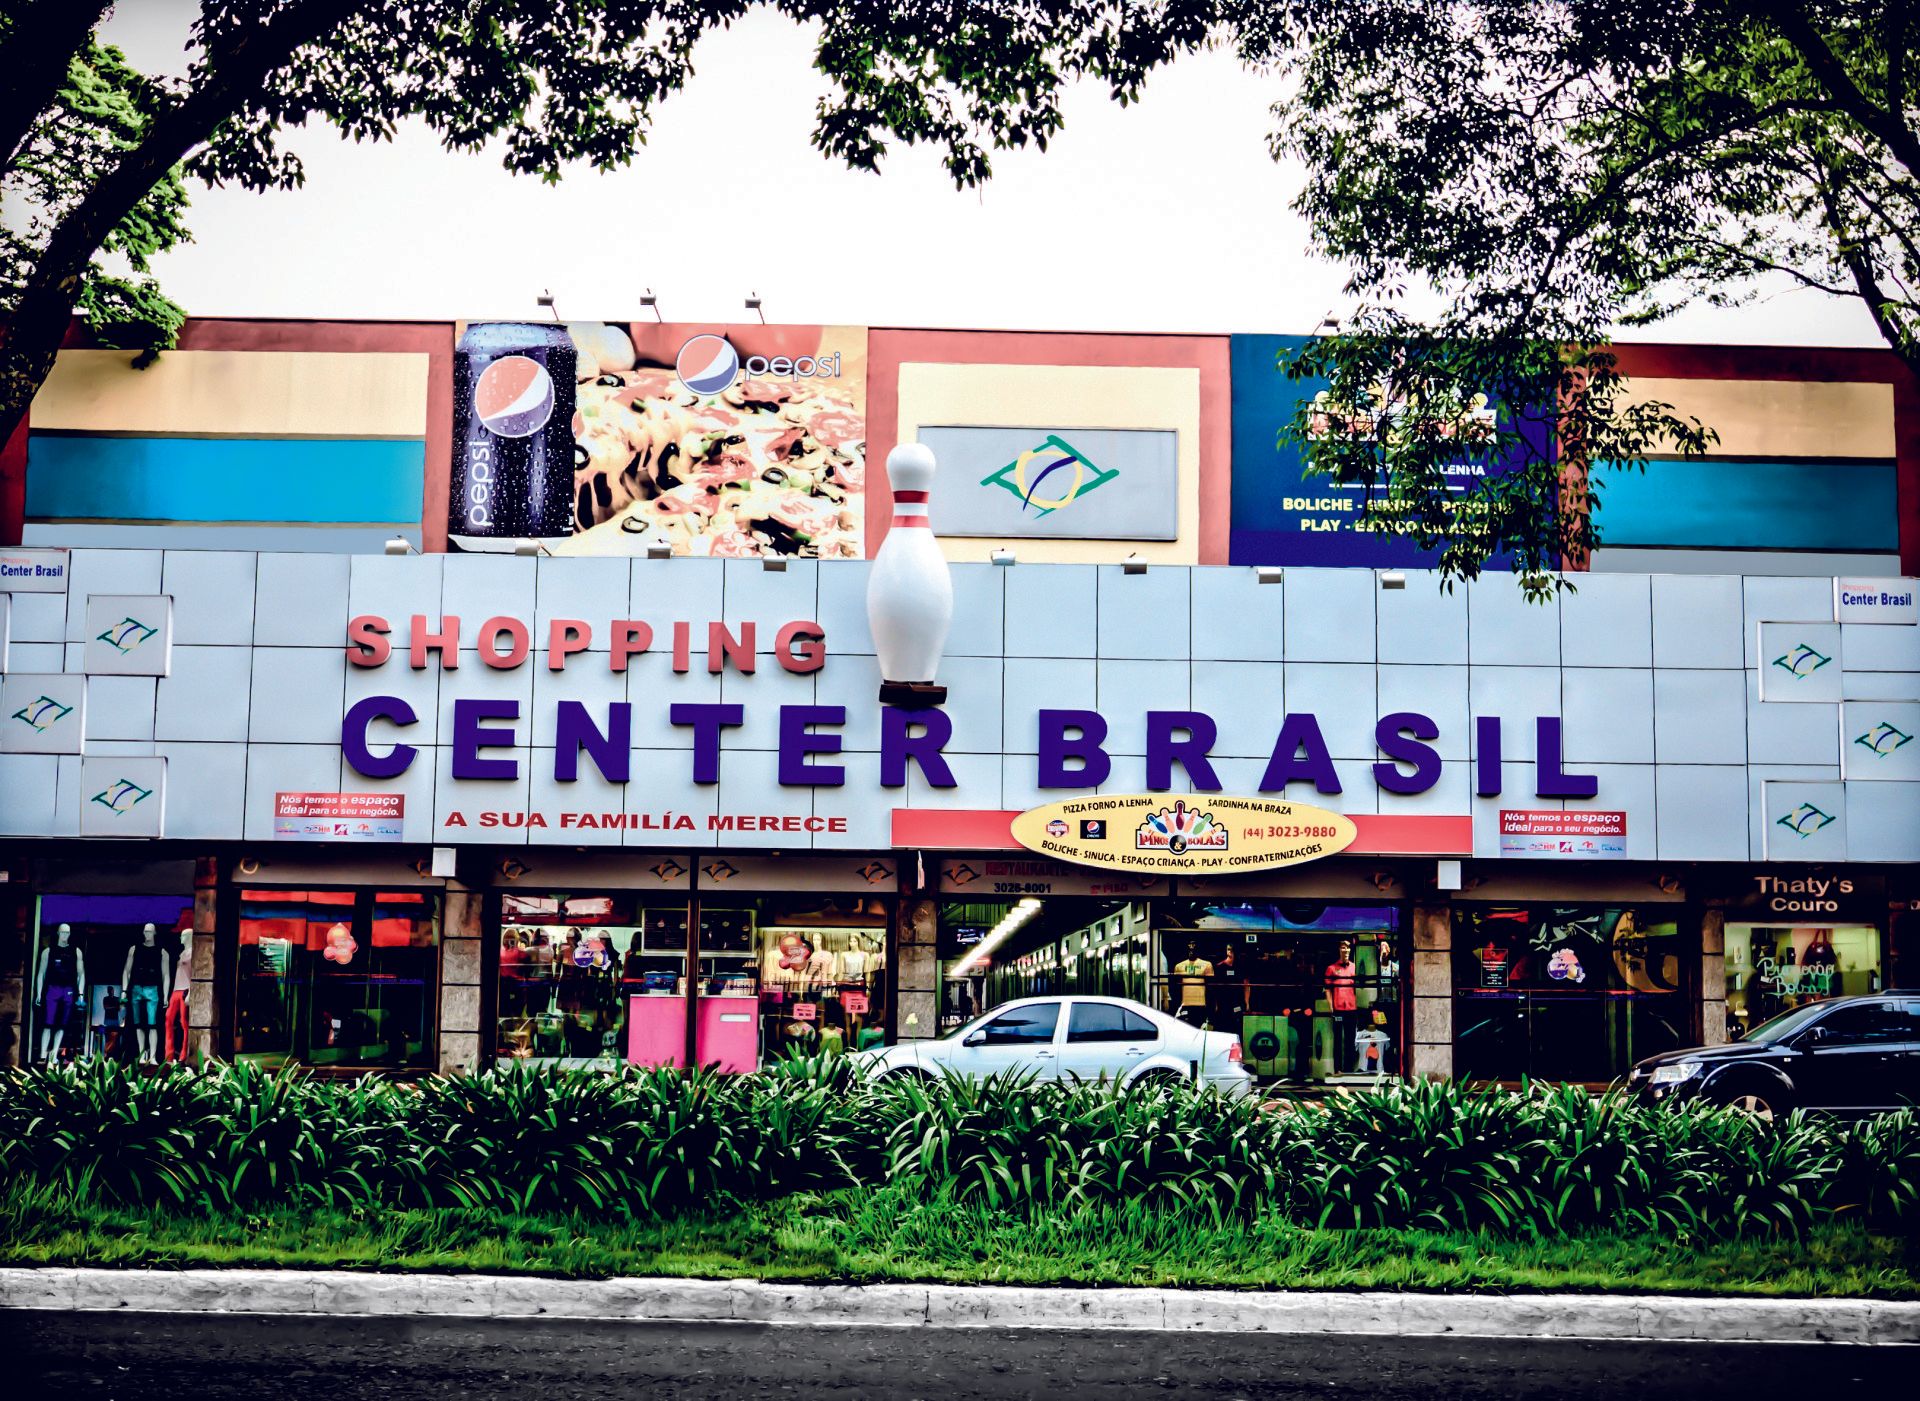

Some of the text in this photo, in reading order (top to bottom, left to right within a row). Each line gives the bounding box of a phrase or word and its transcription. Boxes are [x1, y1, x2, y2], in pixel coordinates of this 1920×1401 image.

[745, 351, 840, 382] pepsi
[469, 441, 493, 526] pepsi
[1283, 497, 1353, 511] BOLICHE
[1301, 519, 1341, 531] PLAY
[1, 565, 63, 577] Center Brasil
[1842, 592, 1912, 606] Center Brasil
[346, 615, 826, 674] SHOPPING
[341, 695, 1598, 799] CENTER BRASIL
[280, 795, 399, 807] Nós temos o espaço
[1063, 798, 1153, 814] PIZZA FORNO A LENHA
[1208, 799, 1292, 815] SARDINHA NA BRAZA
[280, 804, 399, 817] ideal para o seu negócio.
[444, 810, 848, 833] A SUA FAMILÍA MERECE
[1504, 812, 1621, 825] Nós temos o espaço
[1243, 826, 1337, 840] (44) 3023-9880
[1504, 822, 1622, 835] ideal para o seu negócio.
[1042, 840, 1322, 868] BOLICHE SINUCA ESPAÇO CRIANÇA PLAY CONFRATERNIZAÇÕES
[1754, 876, 1854, 912] Thaty's Couro
